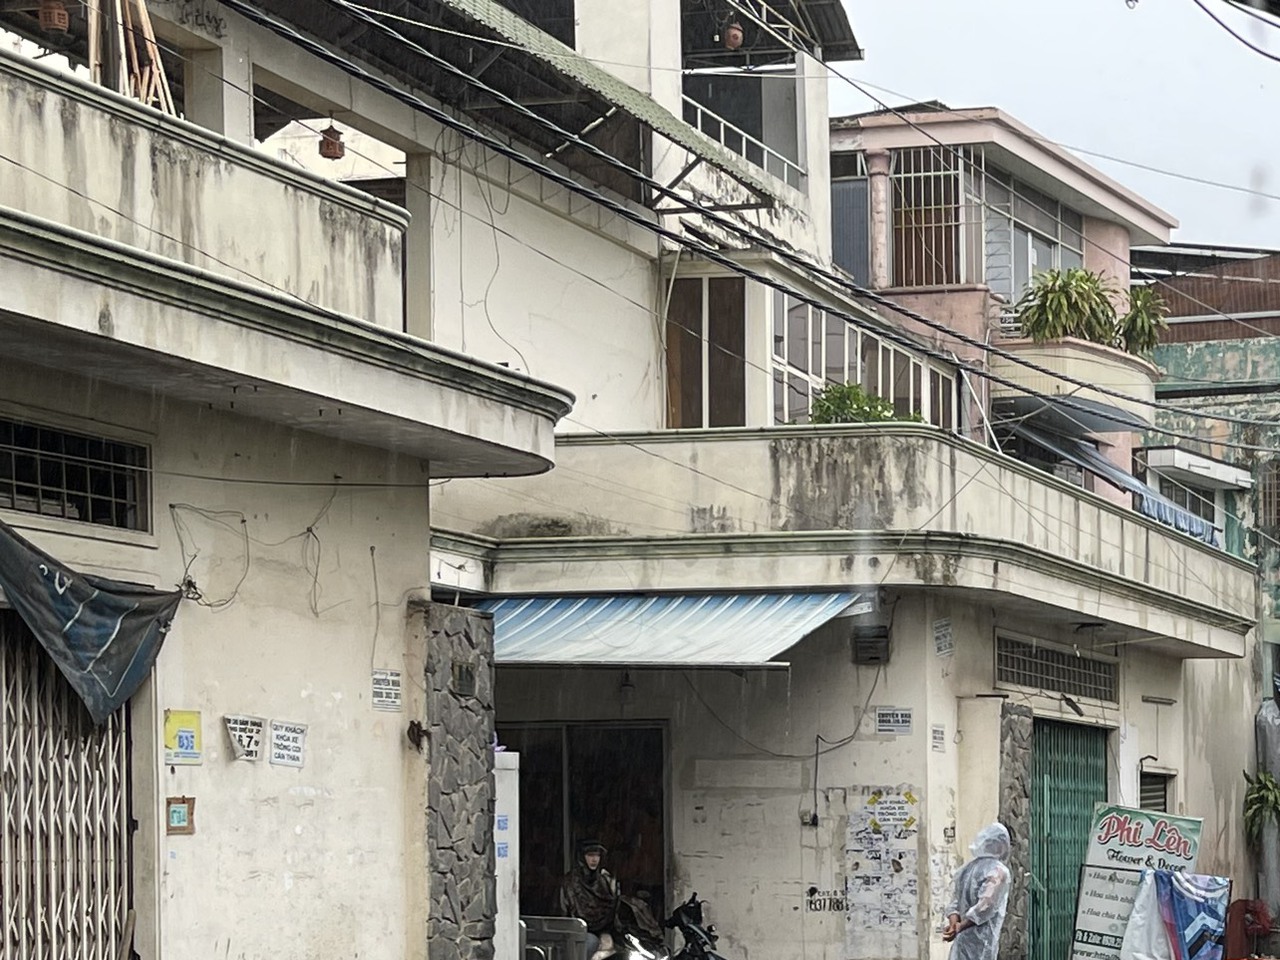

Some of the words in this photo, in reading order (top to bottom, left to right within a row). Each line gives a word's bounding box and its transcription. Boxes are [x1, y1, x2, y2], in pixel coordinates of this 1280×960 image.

[1097, 813, 1143, 847] Phi
[1144, 819, 1194, 860] Lên
[1106, 848, 1145, 866] Flower
